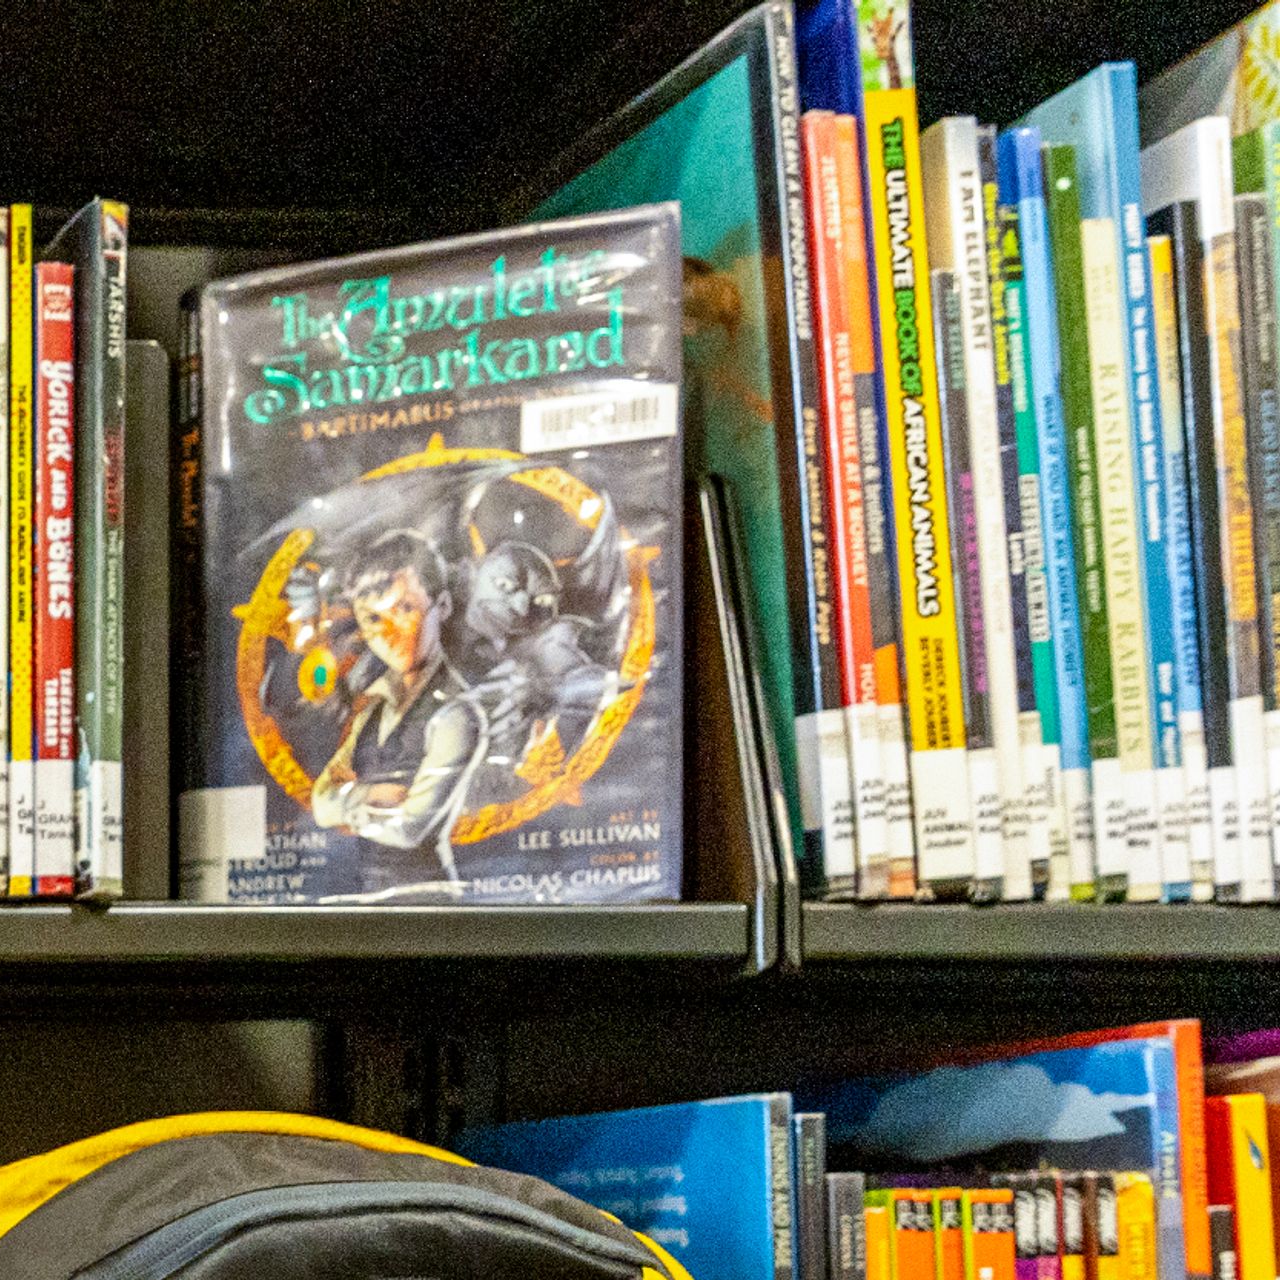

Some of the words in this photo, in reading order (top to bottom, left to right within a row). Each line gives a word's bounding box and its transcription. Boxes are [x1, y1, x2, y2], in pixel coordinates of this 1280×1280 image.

[881, 119, 903, 168] THE
[885, 169, 912, 287] ULTIMATE
[107, 278, 121, 357] TARSHIS
[272, 293, 335, 346] The
[340, 246, 560, 363] Amulet
[893, 290, 918, 355] BOOK
[244, 287, 624, 424] Samarkand
[899, 361, 921, 395] OF
[901, 399, 930, 500] AFRICAN
[1098, 362, 1129, 490] RAISING
[909, 501, 940, 617] ANIMALS
[1108, 506, 1136, 603] HAPPY
[1114, 622, 1145, 754] RABBITS
[474, 872, 563, 896] NICOLAS
[519, 831, 549, 850] LEE
[560, 823, 660, 846] SULLIVAN
